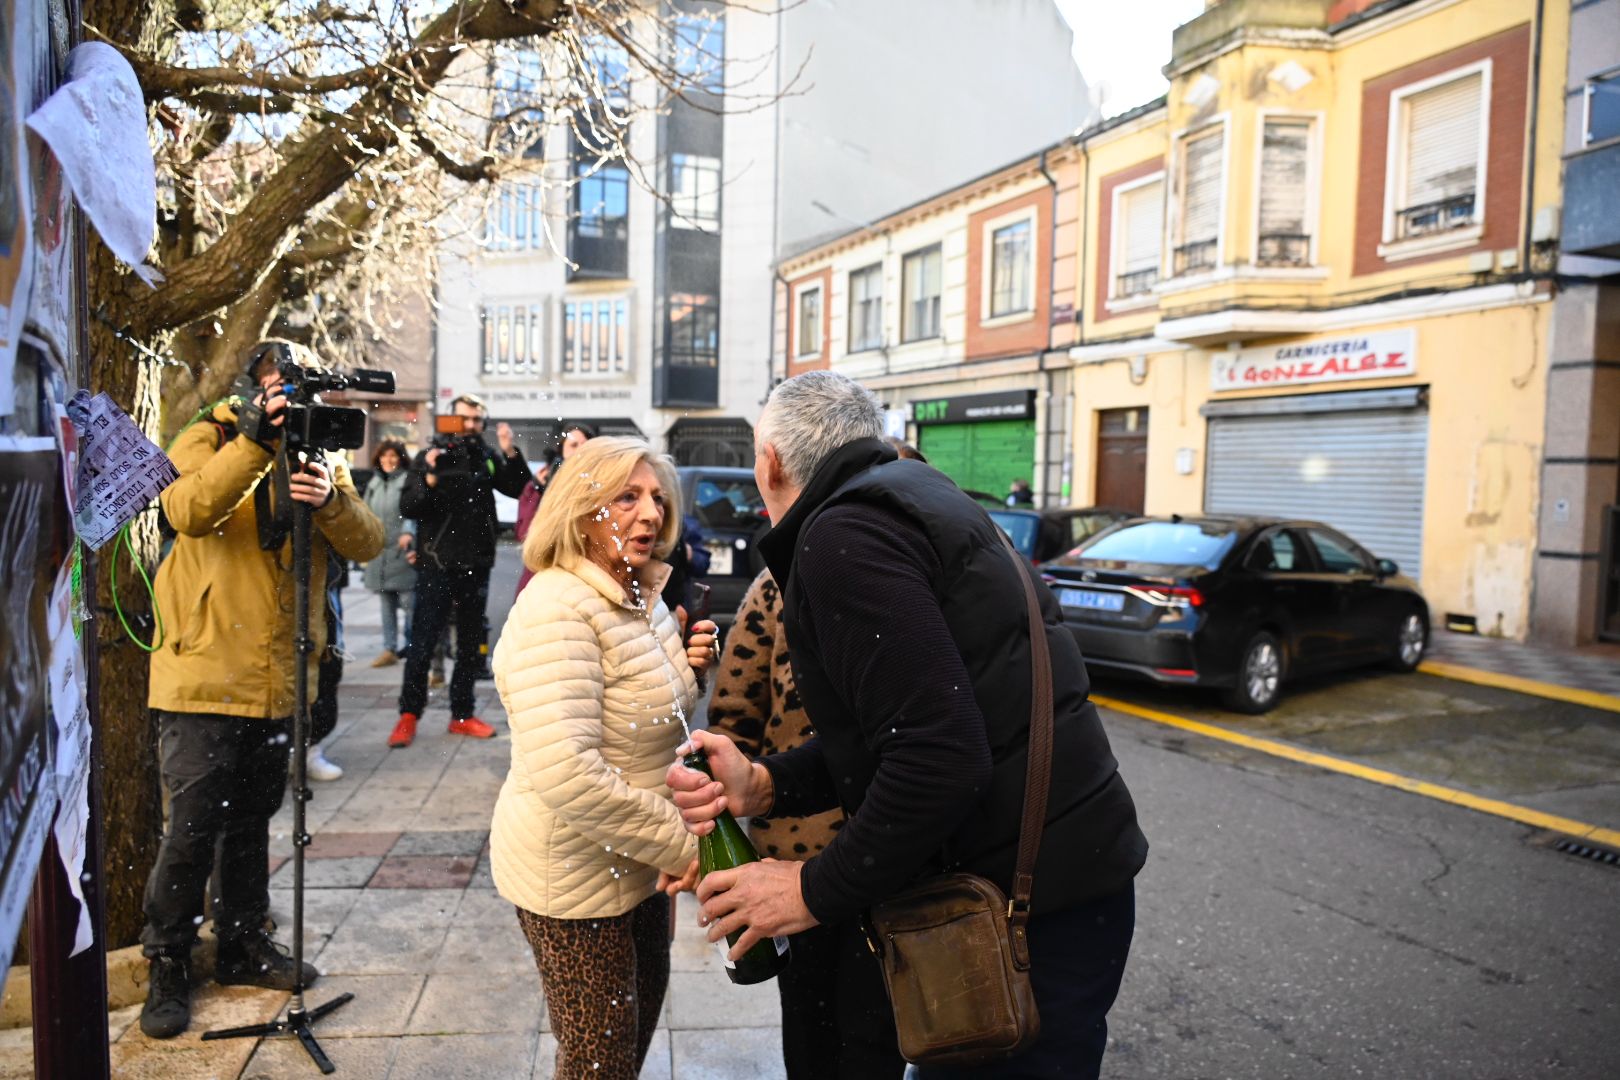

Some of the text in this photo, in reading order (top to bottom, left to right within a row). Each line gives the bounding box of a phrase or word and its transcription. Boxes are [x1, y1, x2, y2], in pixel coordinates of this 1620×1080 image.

[1276, 340, 1369, 360] CARNICERIA
[93, 414, 109, 430] EL
[133, 446, 149, 461] NO
[110, 461, 131, 480] SOLO
[93, 479, 110, 494] SON
[99, 467, 159, 520] LA VIOLENCIA
